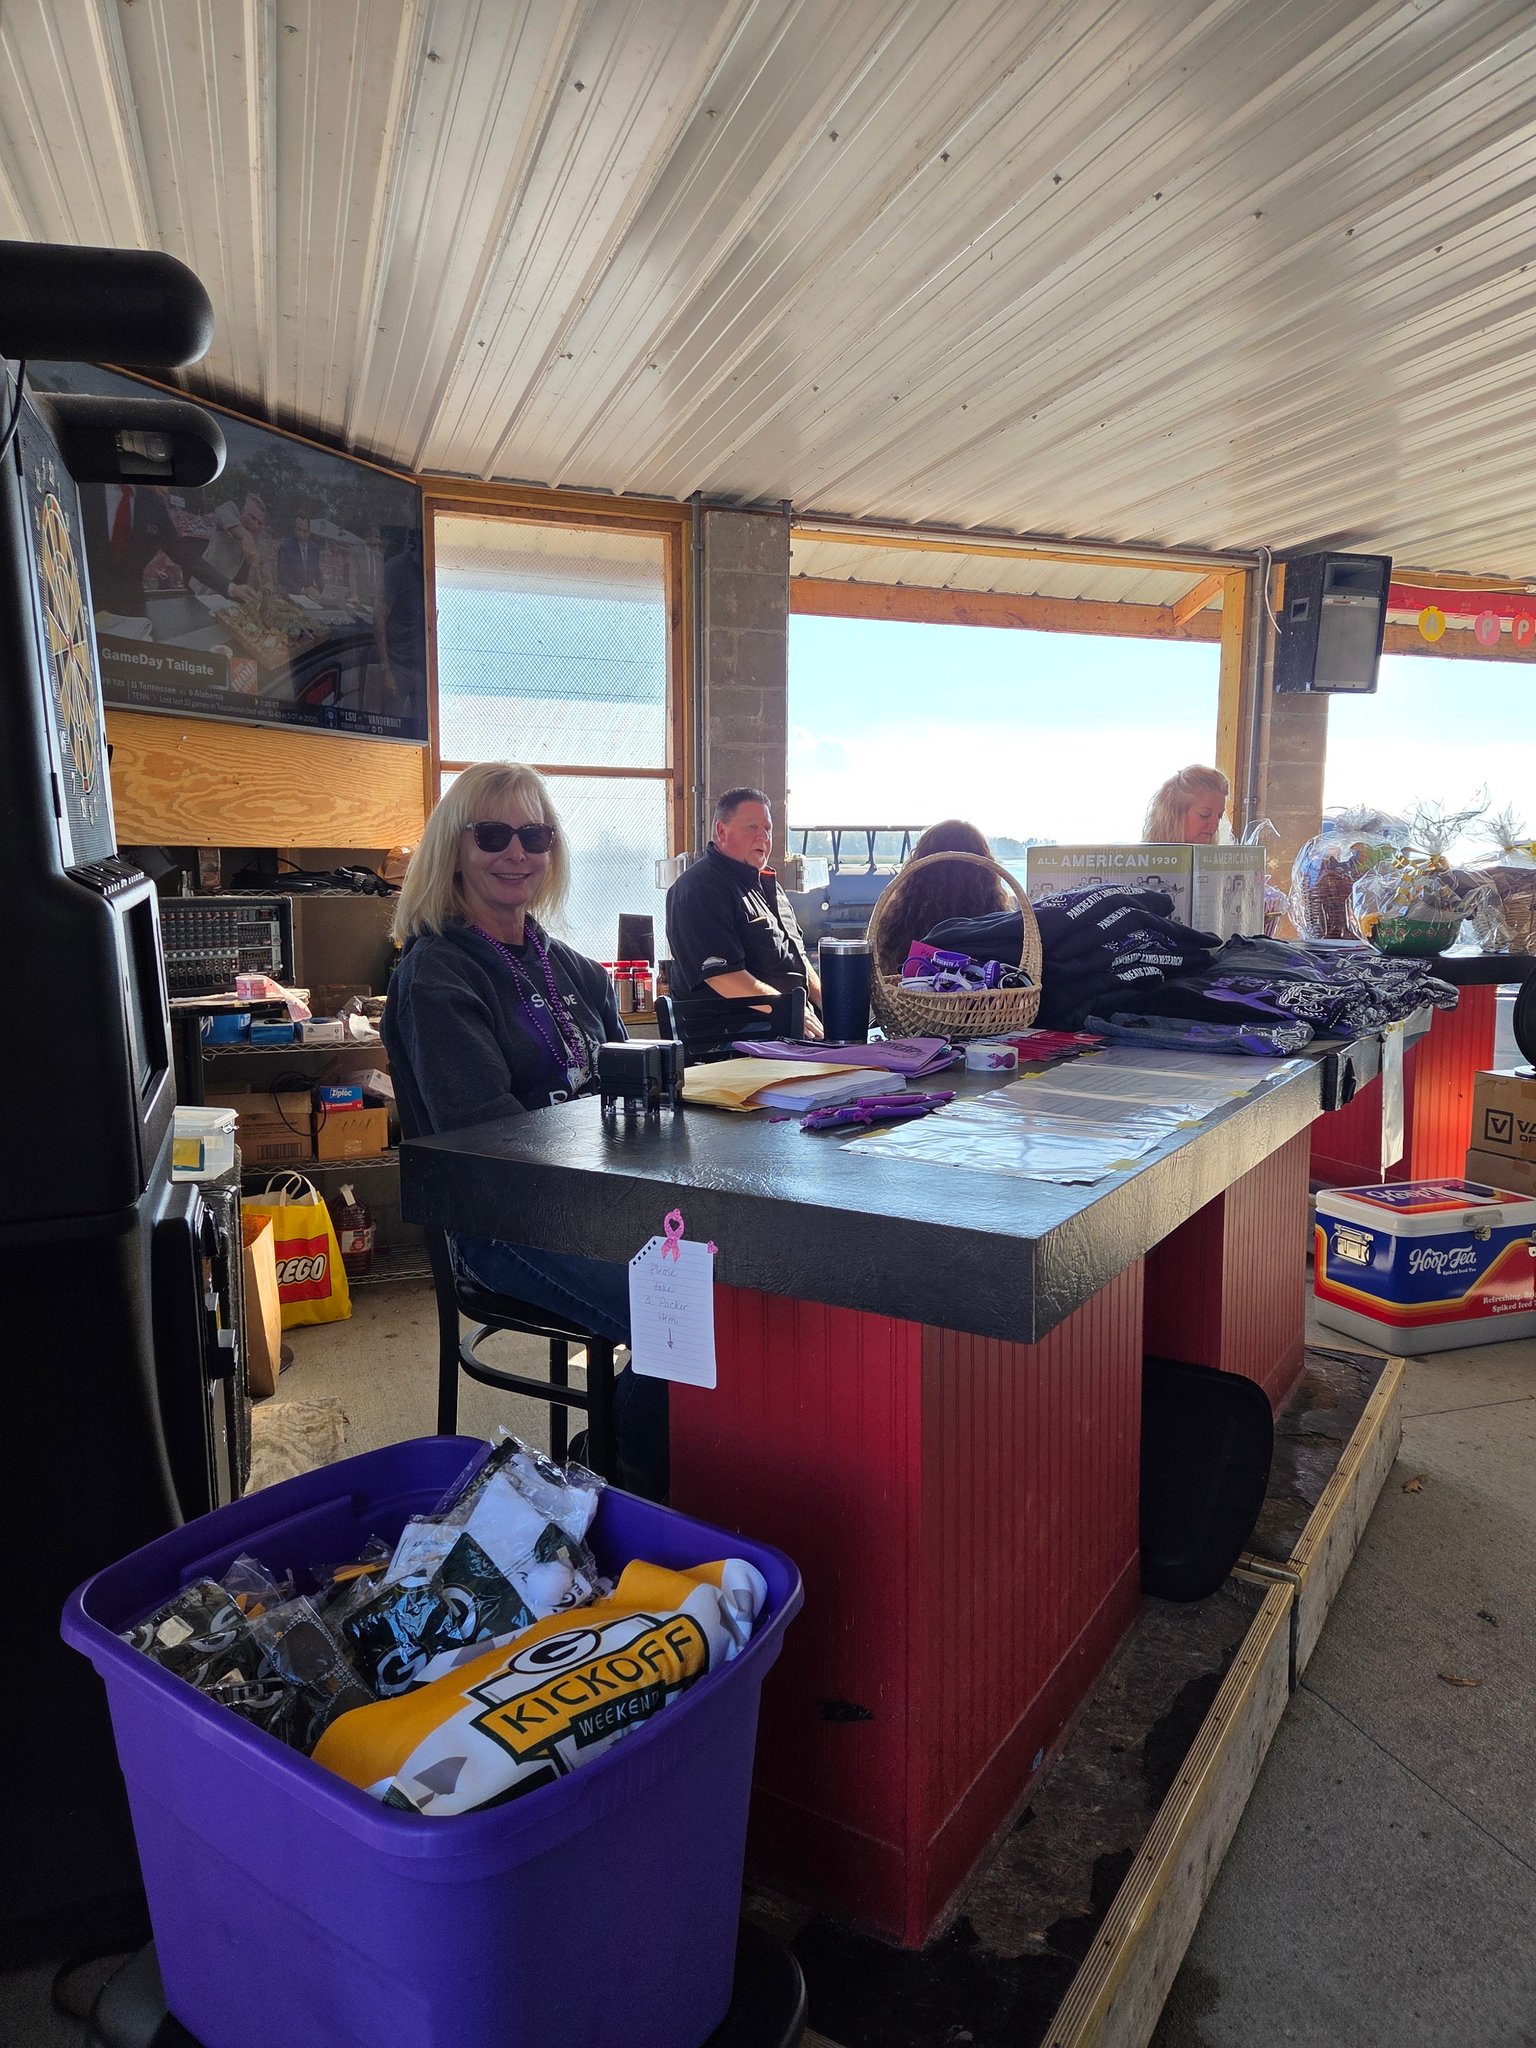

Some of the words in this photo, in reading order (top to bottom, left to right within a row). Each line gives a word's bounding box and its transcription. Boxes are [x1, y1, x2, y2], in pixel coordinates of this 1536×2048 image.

[102, 648, 163, 671] GameDay
[166, 658, 215, 677] Tailgate
[138, 681, 177, 695] Tennessee
[194, 689, 224, 701] Alabama
[345, 711, 357, 722] LSU
[1037, 857, 1058, 866] ALL
[1060, 854, 1149, 868] AMERICAN
[1151, 856, 1178, 865] 1930
[1213, 852, 1250, 865] AMERICAN
[1066, 891, 1103, 920] PANCREATIC
[330, 1088, 353, 1099] Ziploc
[1408, 1248, 1449, 1275] Hoop
[1449, 1244, 1477, 1269] Tea
[1492, 1303, 1517, 1314] Spiked
[1518, 1300, 1533, 1310] Iced
[499, 1624, 695, 1737] KICKOFF
[577, 1690, 661, 1740] WEEKEND
